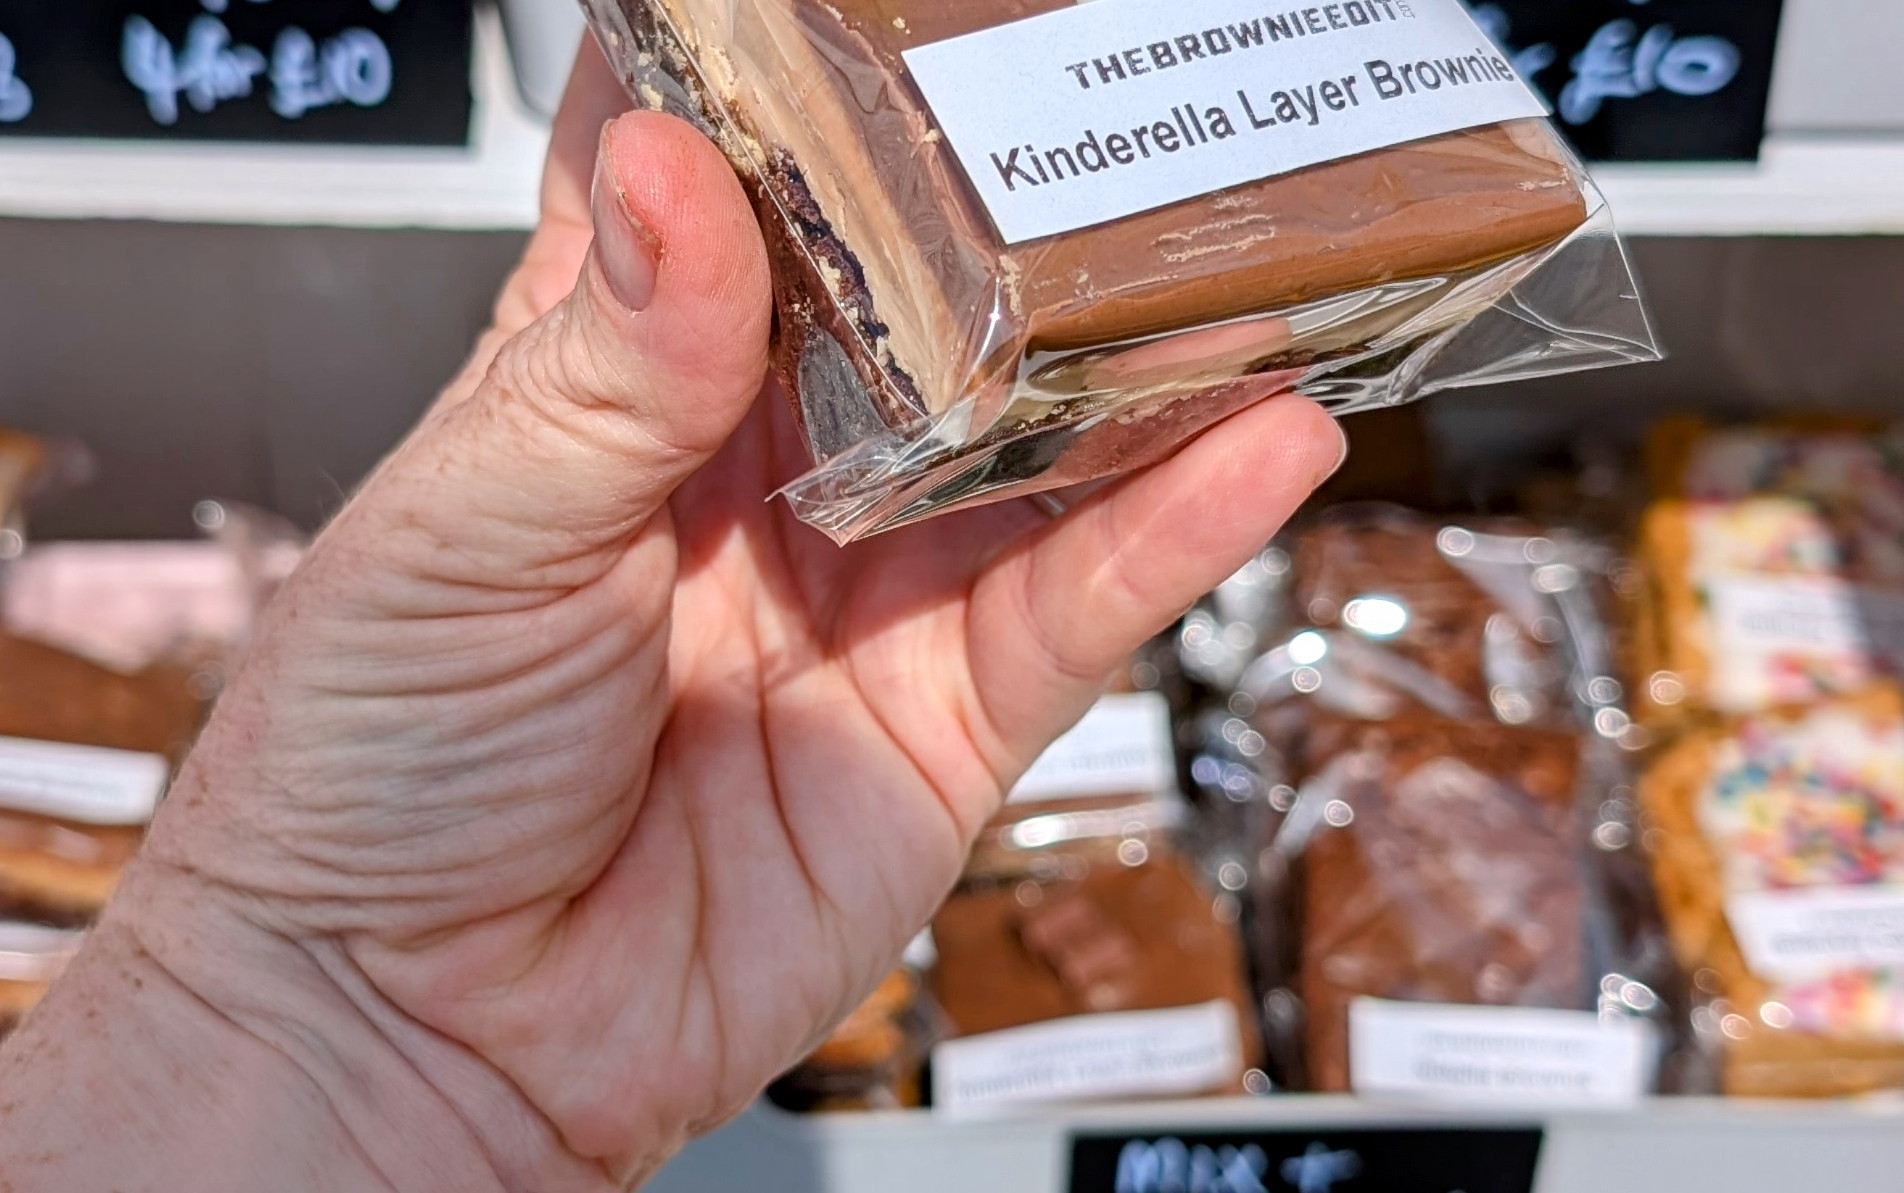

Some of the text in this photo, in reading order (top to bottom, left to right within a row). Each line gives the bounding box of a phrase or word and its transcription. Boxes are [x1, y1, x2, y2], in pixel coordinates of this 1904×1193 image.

[990, 50, 1514, 192] Kinderella Layer Brownie
[1559, 19, 1742, 124] £10
